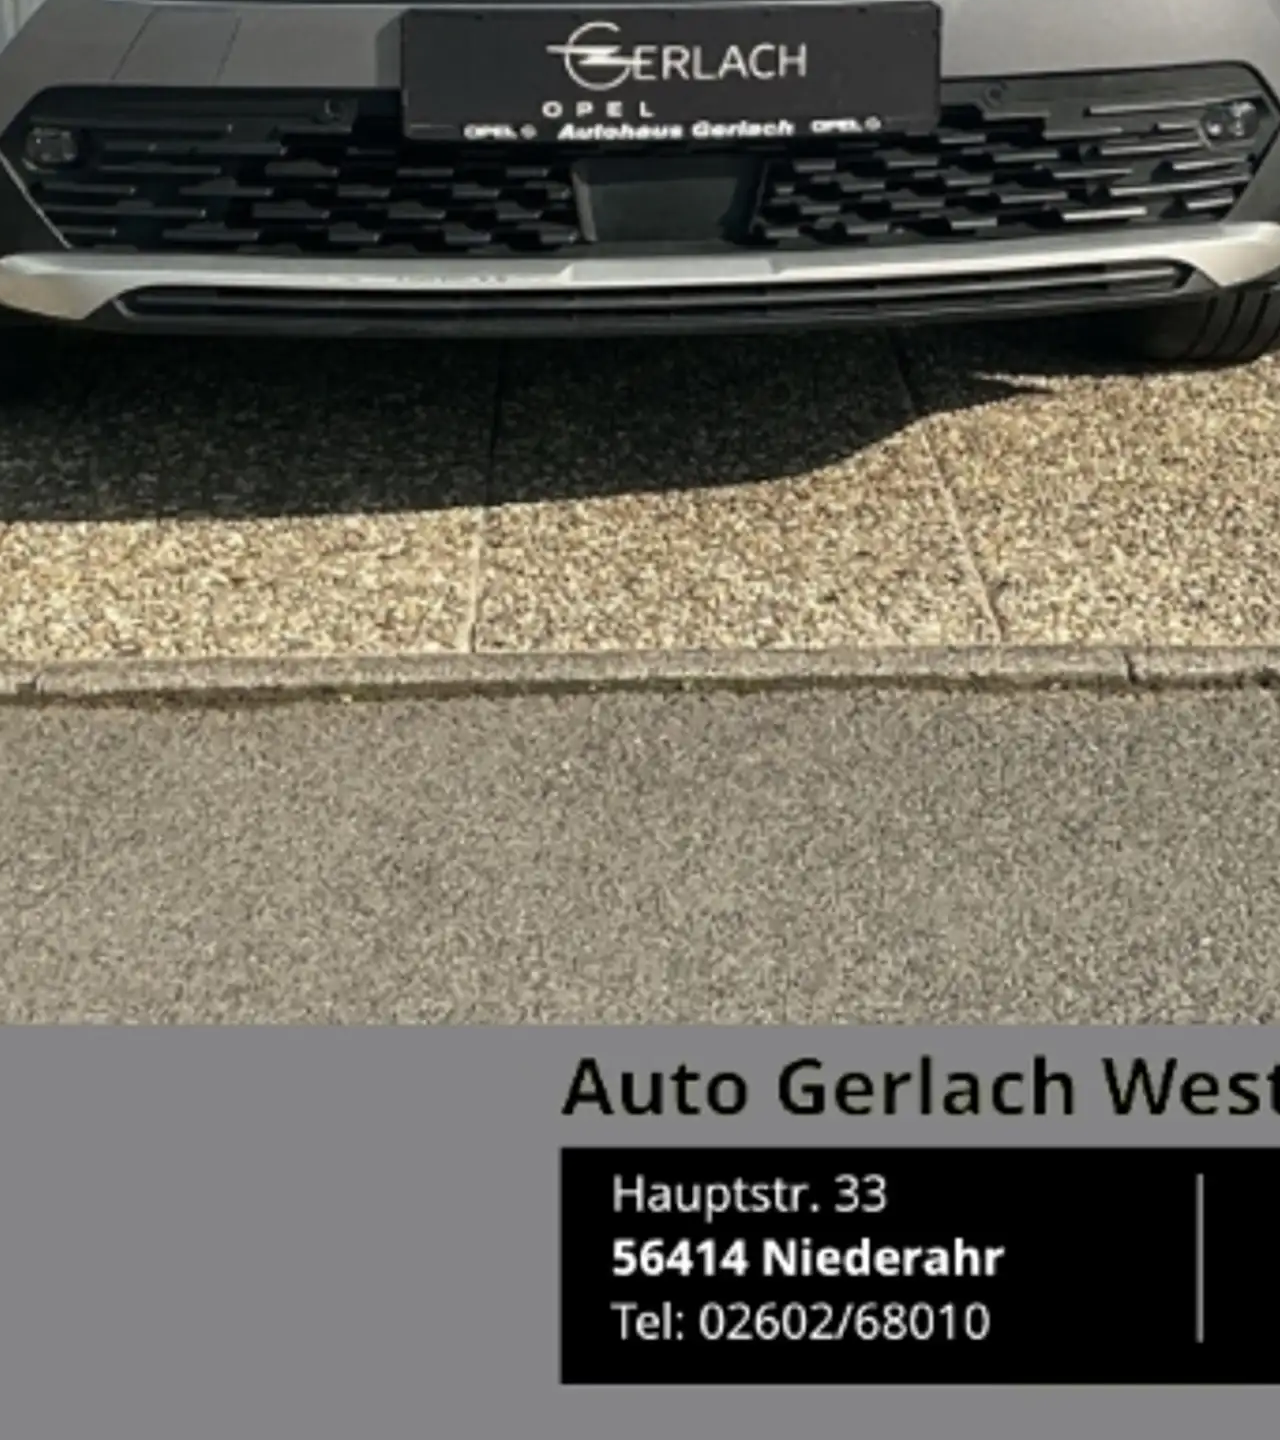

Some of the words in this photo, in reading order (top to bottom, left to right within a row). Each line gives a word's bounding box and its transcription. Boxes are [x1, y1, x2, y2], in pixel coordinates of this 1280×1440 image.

[560, 20, 809, 91] GERLACH
[541, 100, 655, 119] OPEL
[557, 123, 683, 141] Autohaus
[691, 119, 795, 139] Gerlach
